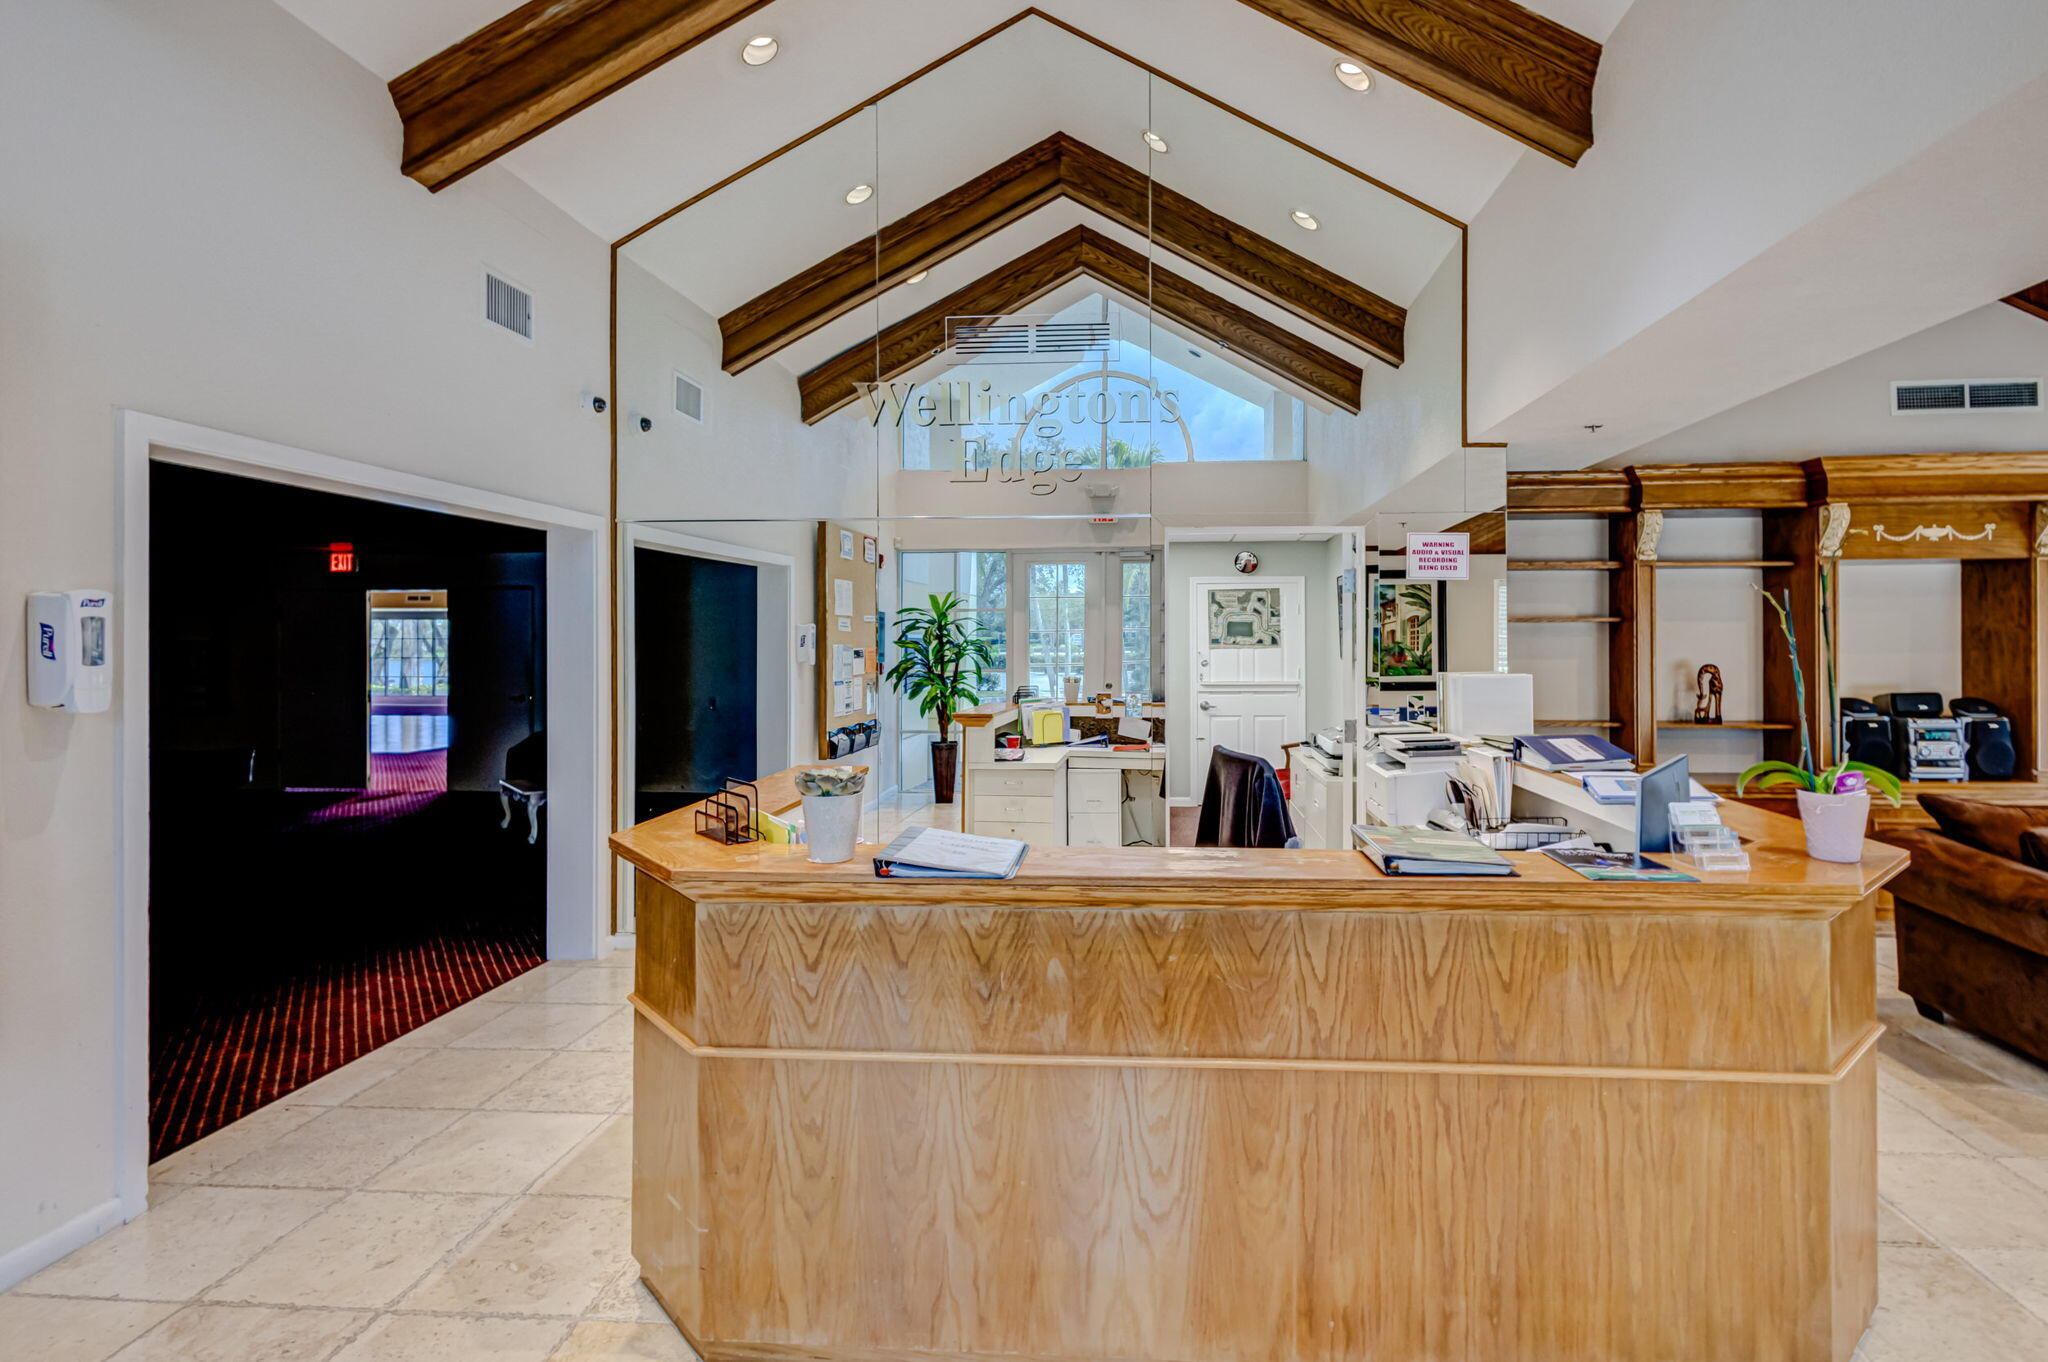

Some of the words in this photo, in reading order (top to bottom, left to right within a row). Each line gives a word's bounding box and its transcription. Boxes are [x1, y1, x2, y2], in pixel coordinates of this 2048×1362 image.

[852, 377, 1180, 438] Wellington's
[949, 437, 1083, 496] Edge
[331, 553, 353, 571] EXIT
